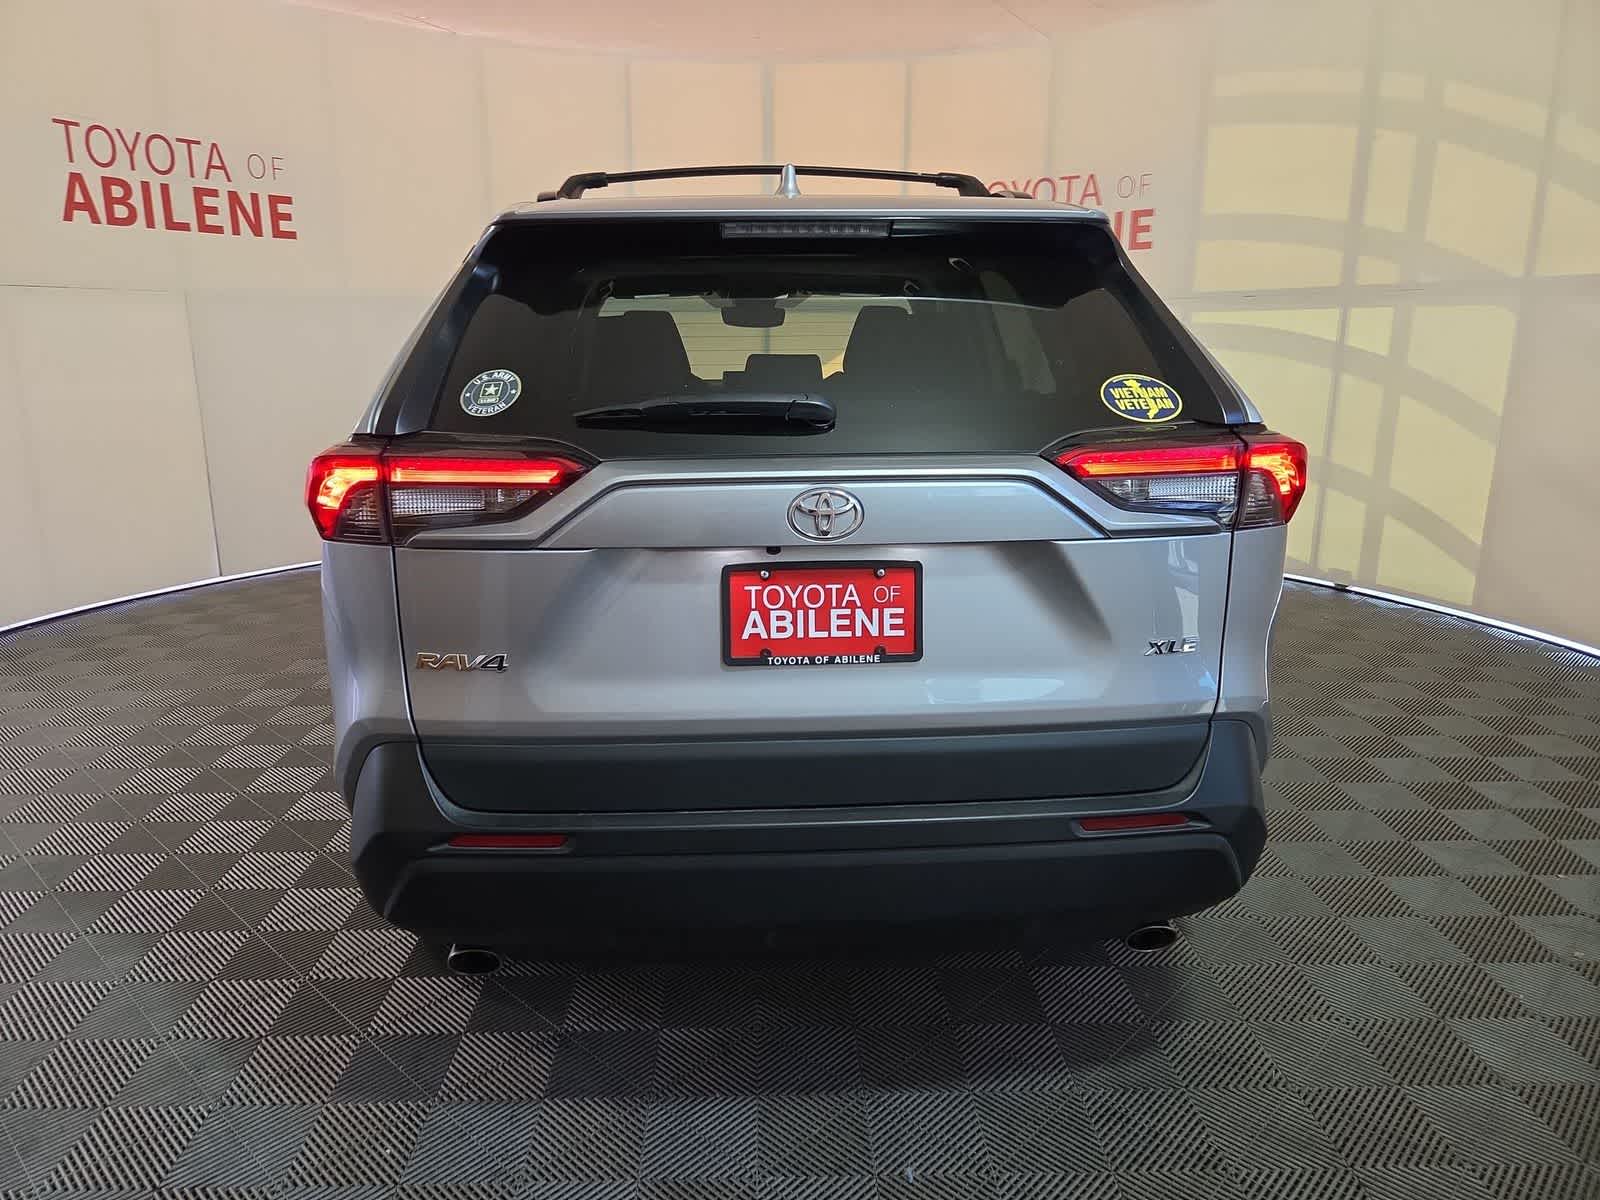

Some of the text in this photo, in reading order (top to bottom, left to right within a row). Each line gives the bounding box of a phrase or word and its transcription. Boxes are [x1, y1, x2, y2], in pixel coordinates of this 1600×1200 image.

[51, 117, 285, 183] TOYOTA OF
[1117, 173, 1153, 199] OF
[62, 171, 298, 240] ABILENE
[491, 371, 516, 383] ARMY
[1109, 387, 1169, 399] VIETNAM
[467, 401, 506, 415] VETERAN
[1114, 398, 1176, 410] VETEAN
[743, 583, 902, 610] TOYOTA OF
[741, 607, 905, 640] ABILENE
[1143, 637, 1198, 656] XLE
[416, 652, 509, 672] RAV4
[768, 655, 881, 665] TOYOTA OF ABILENE
